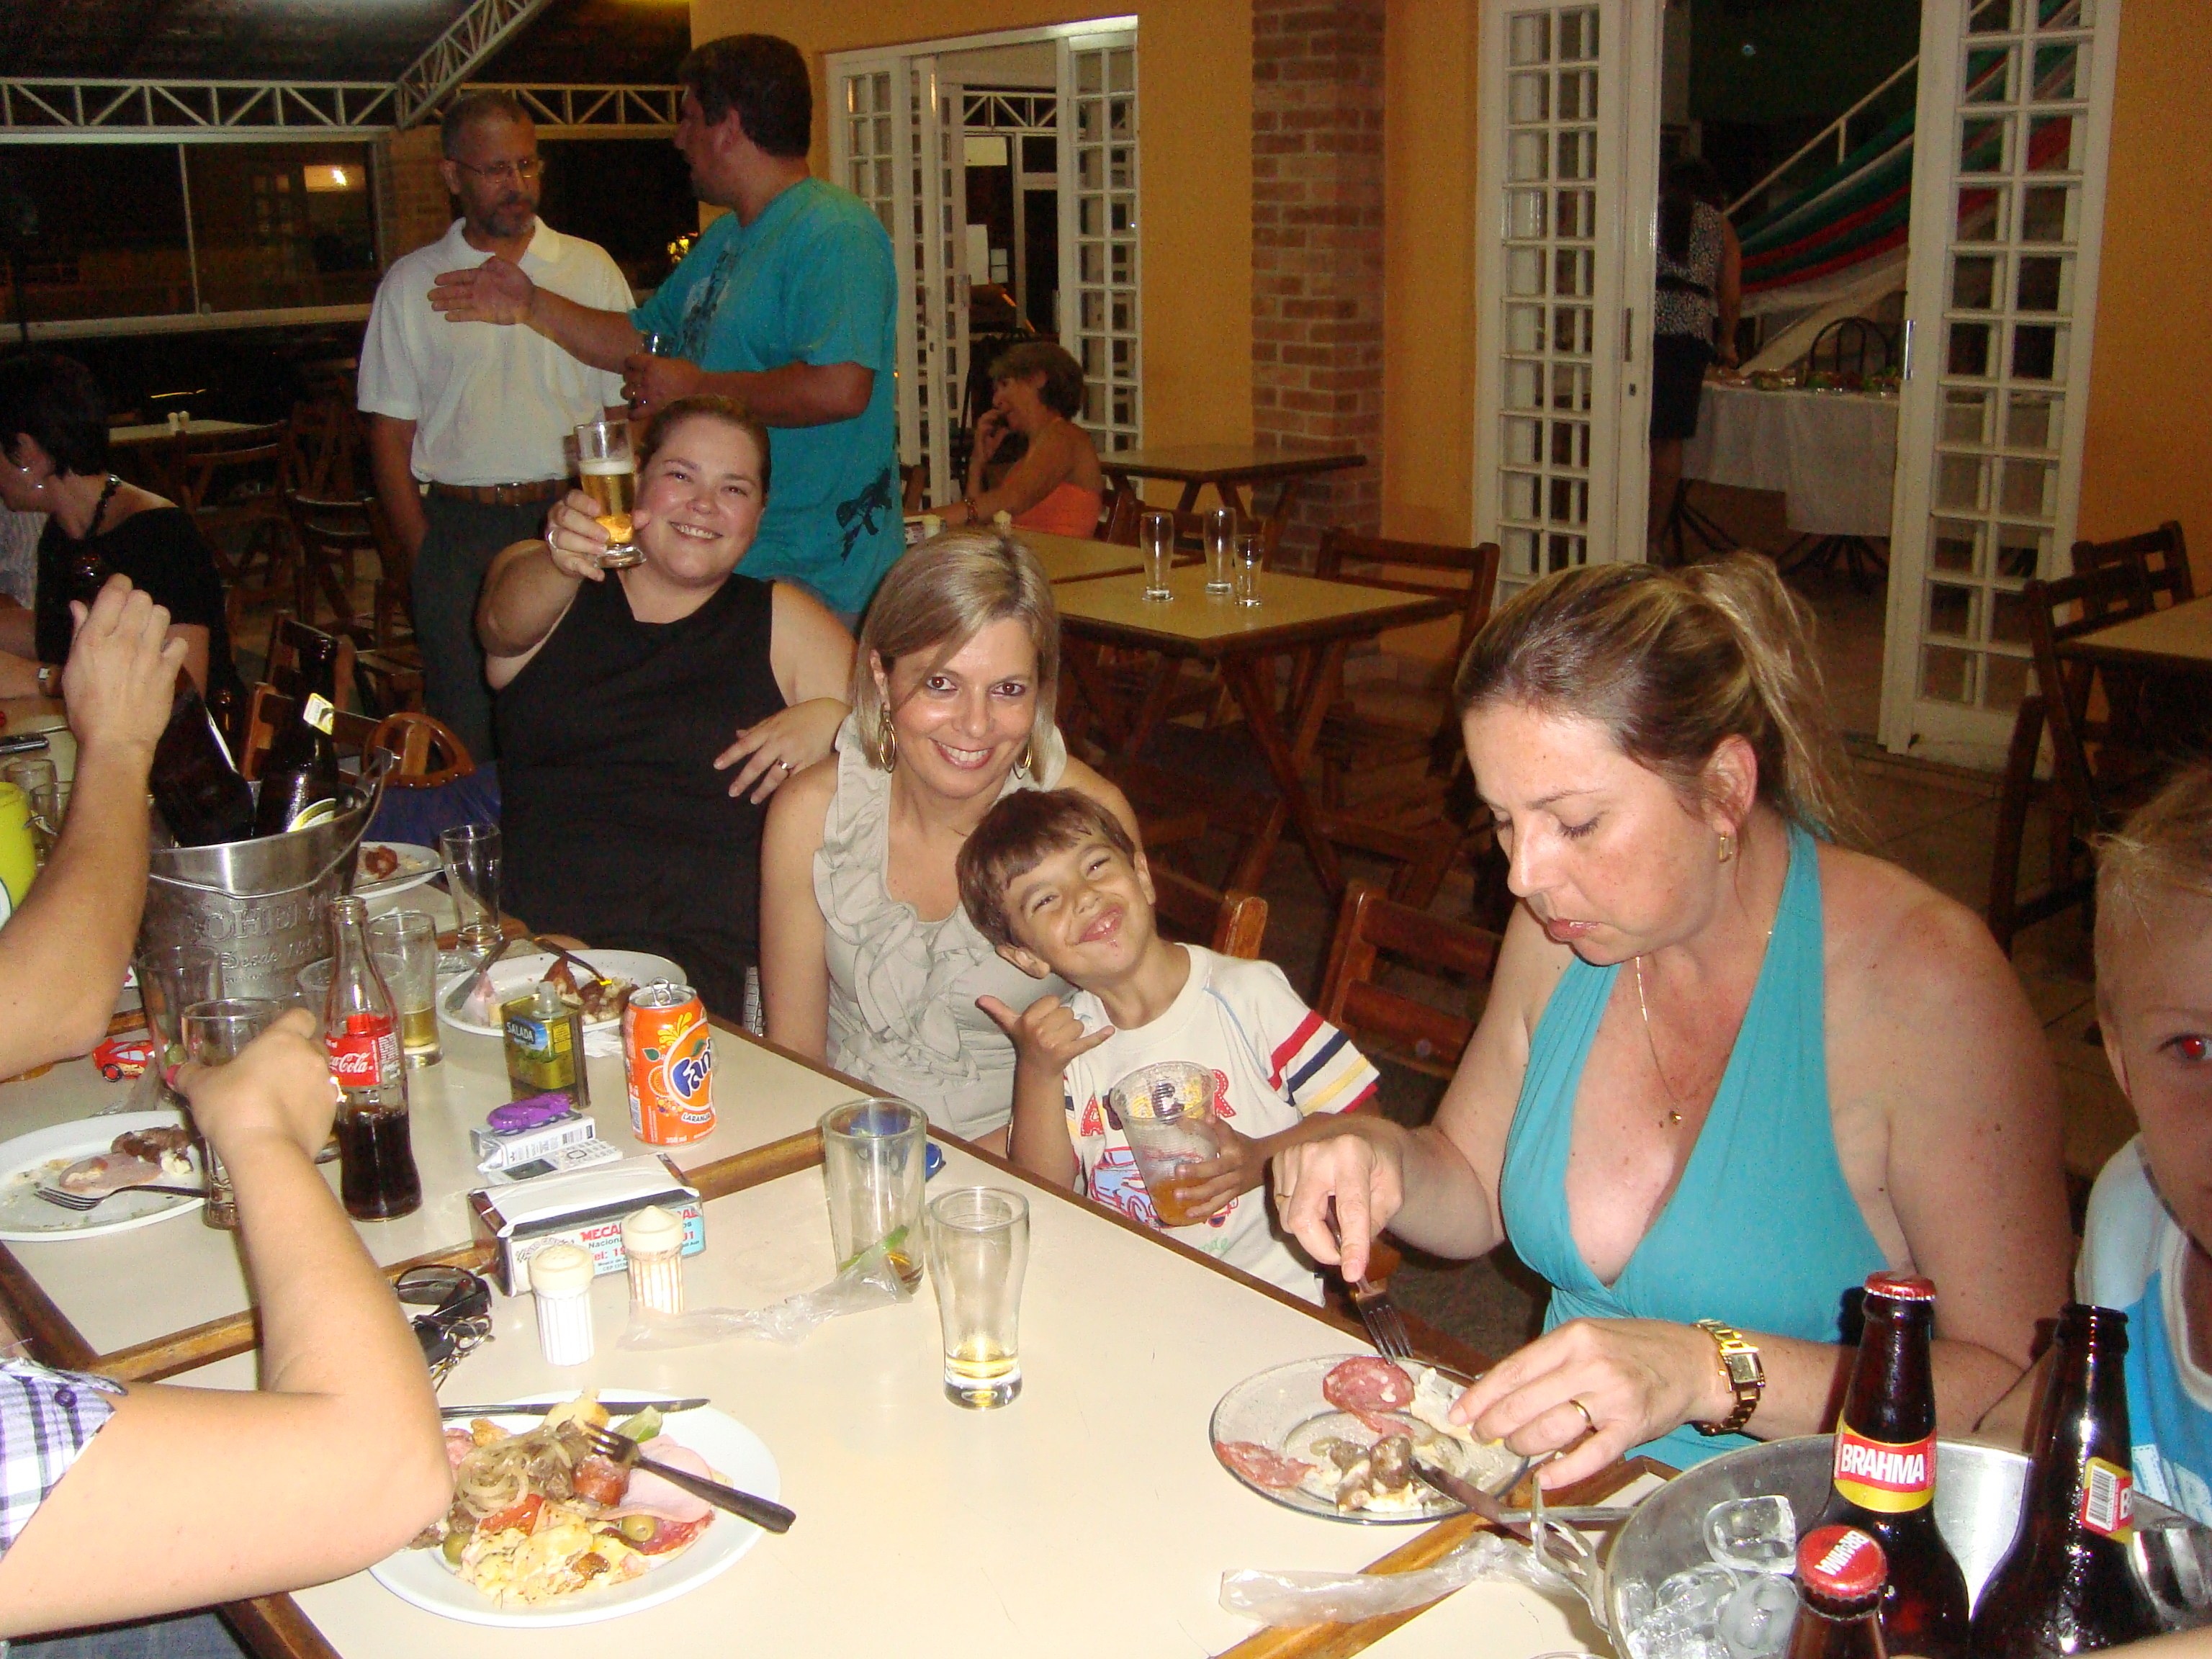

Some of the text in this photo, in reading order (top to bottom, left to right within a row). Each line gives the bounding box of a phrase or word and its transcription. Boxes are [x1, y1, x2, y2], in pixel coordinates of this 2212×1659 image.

[506, 1022, 534, 1044] SALADA
[588, 1238, 621, 1249] Nacion
[1840, 1444, 1925, 1485] BRAHMA
[1814, 1529, 1870, 1576] BRAHMA
